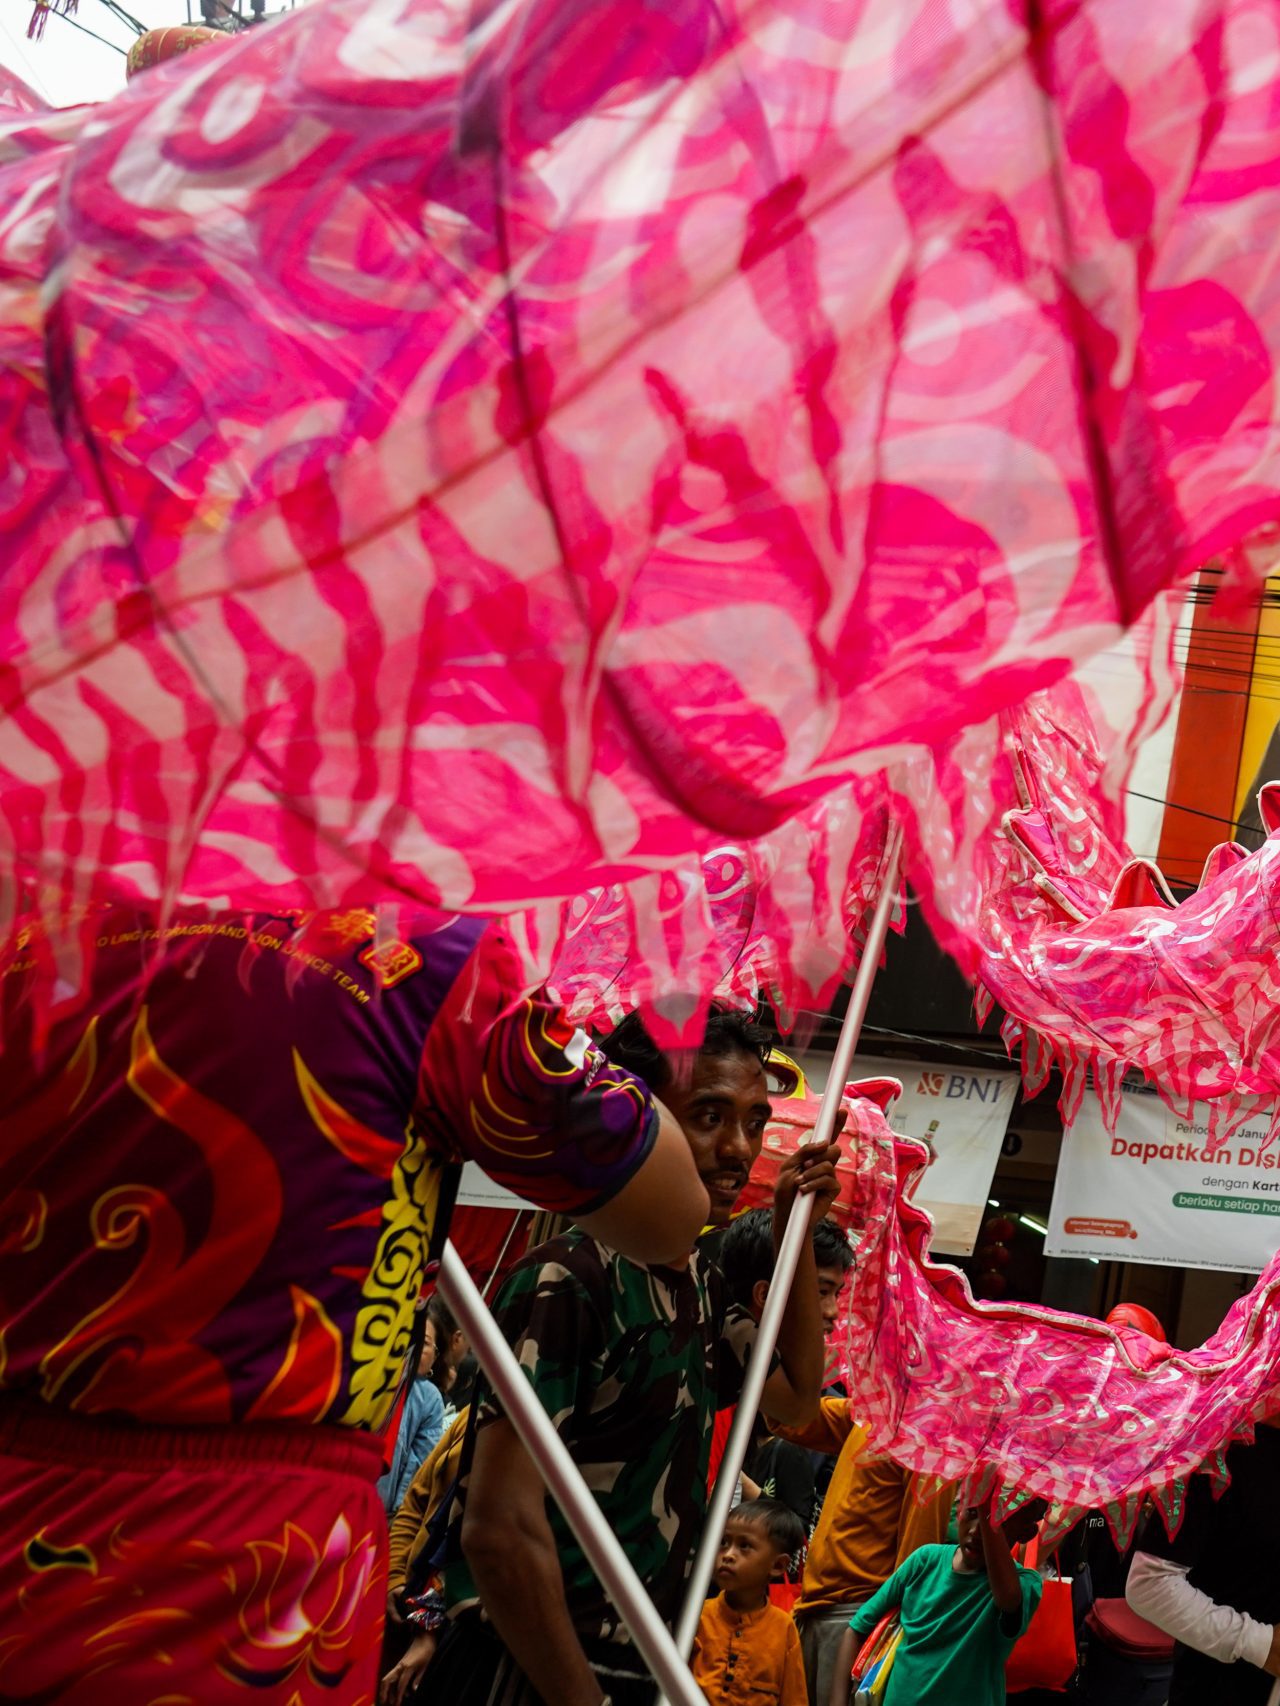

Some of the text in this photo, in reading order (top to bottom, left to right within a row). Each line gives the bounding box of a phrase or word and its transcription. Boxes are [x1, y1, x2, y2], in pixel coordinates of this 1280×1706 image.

[216, 925, 247, 939] AND
[332, 967, 371, 1005] TEAM
[946, 1075, 1004, 1103] BNI
[1110, 1137, 1232, 1166] Dapatkan
[1202, 1175, 1249, 1191] dengan
[1179, 1194, 1222, 1208] berlaku
[1224, 1199, 1260, 1213] setiap
[1089, 1517, 1105, 1528] ma
